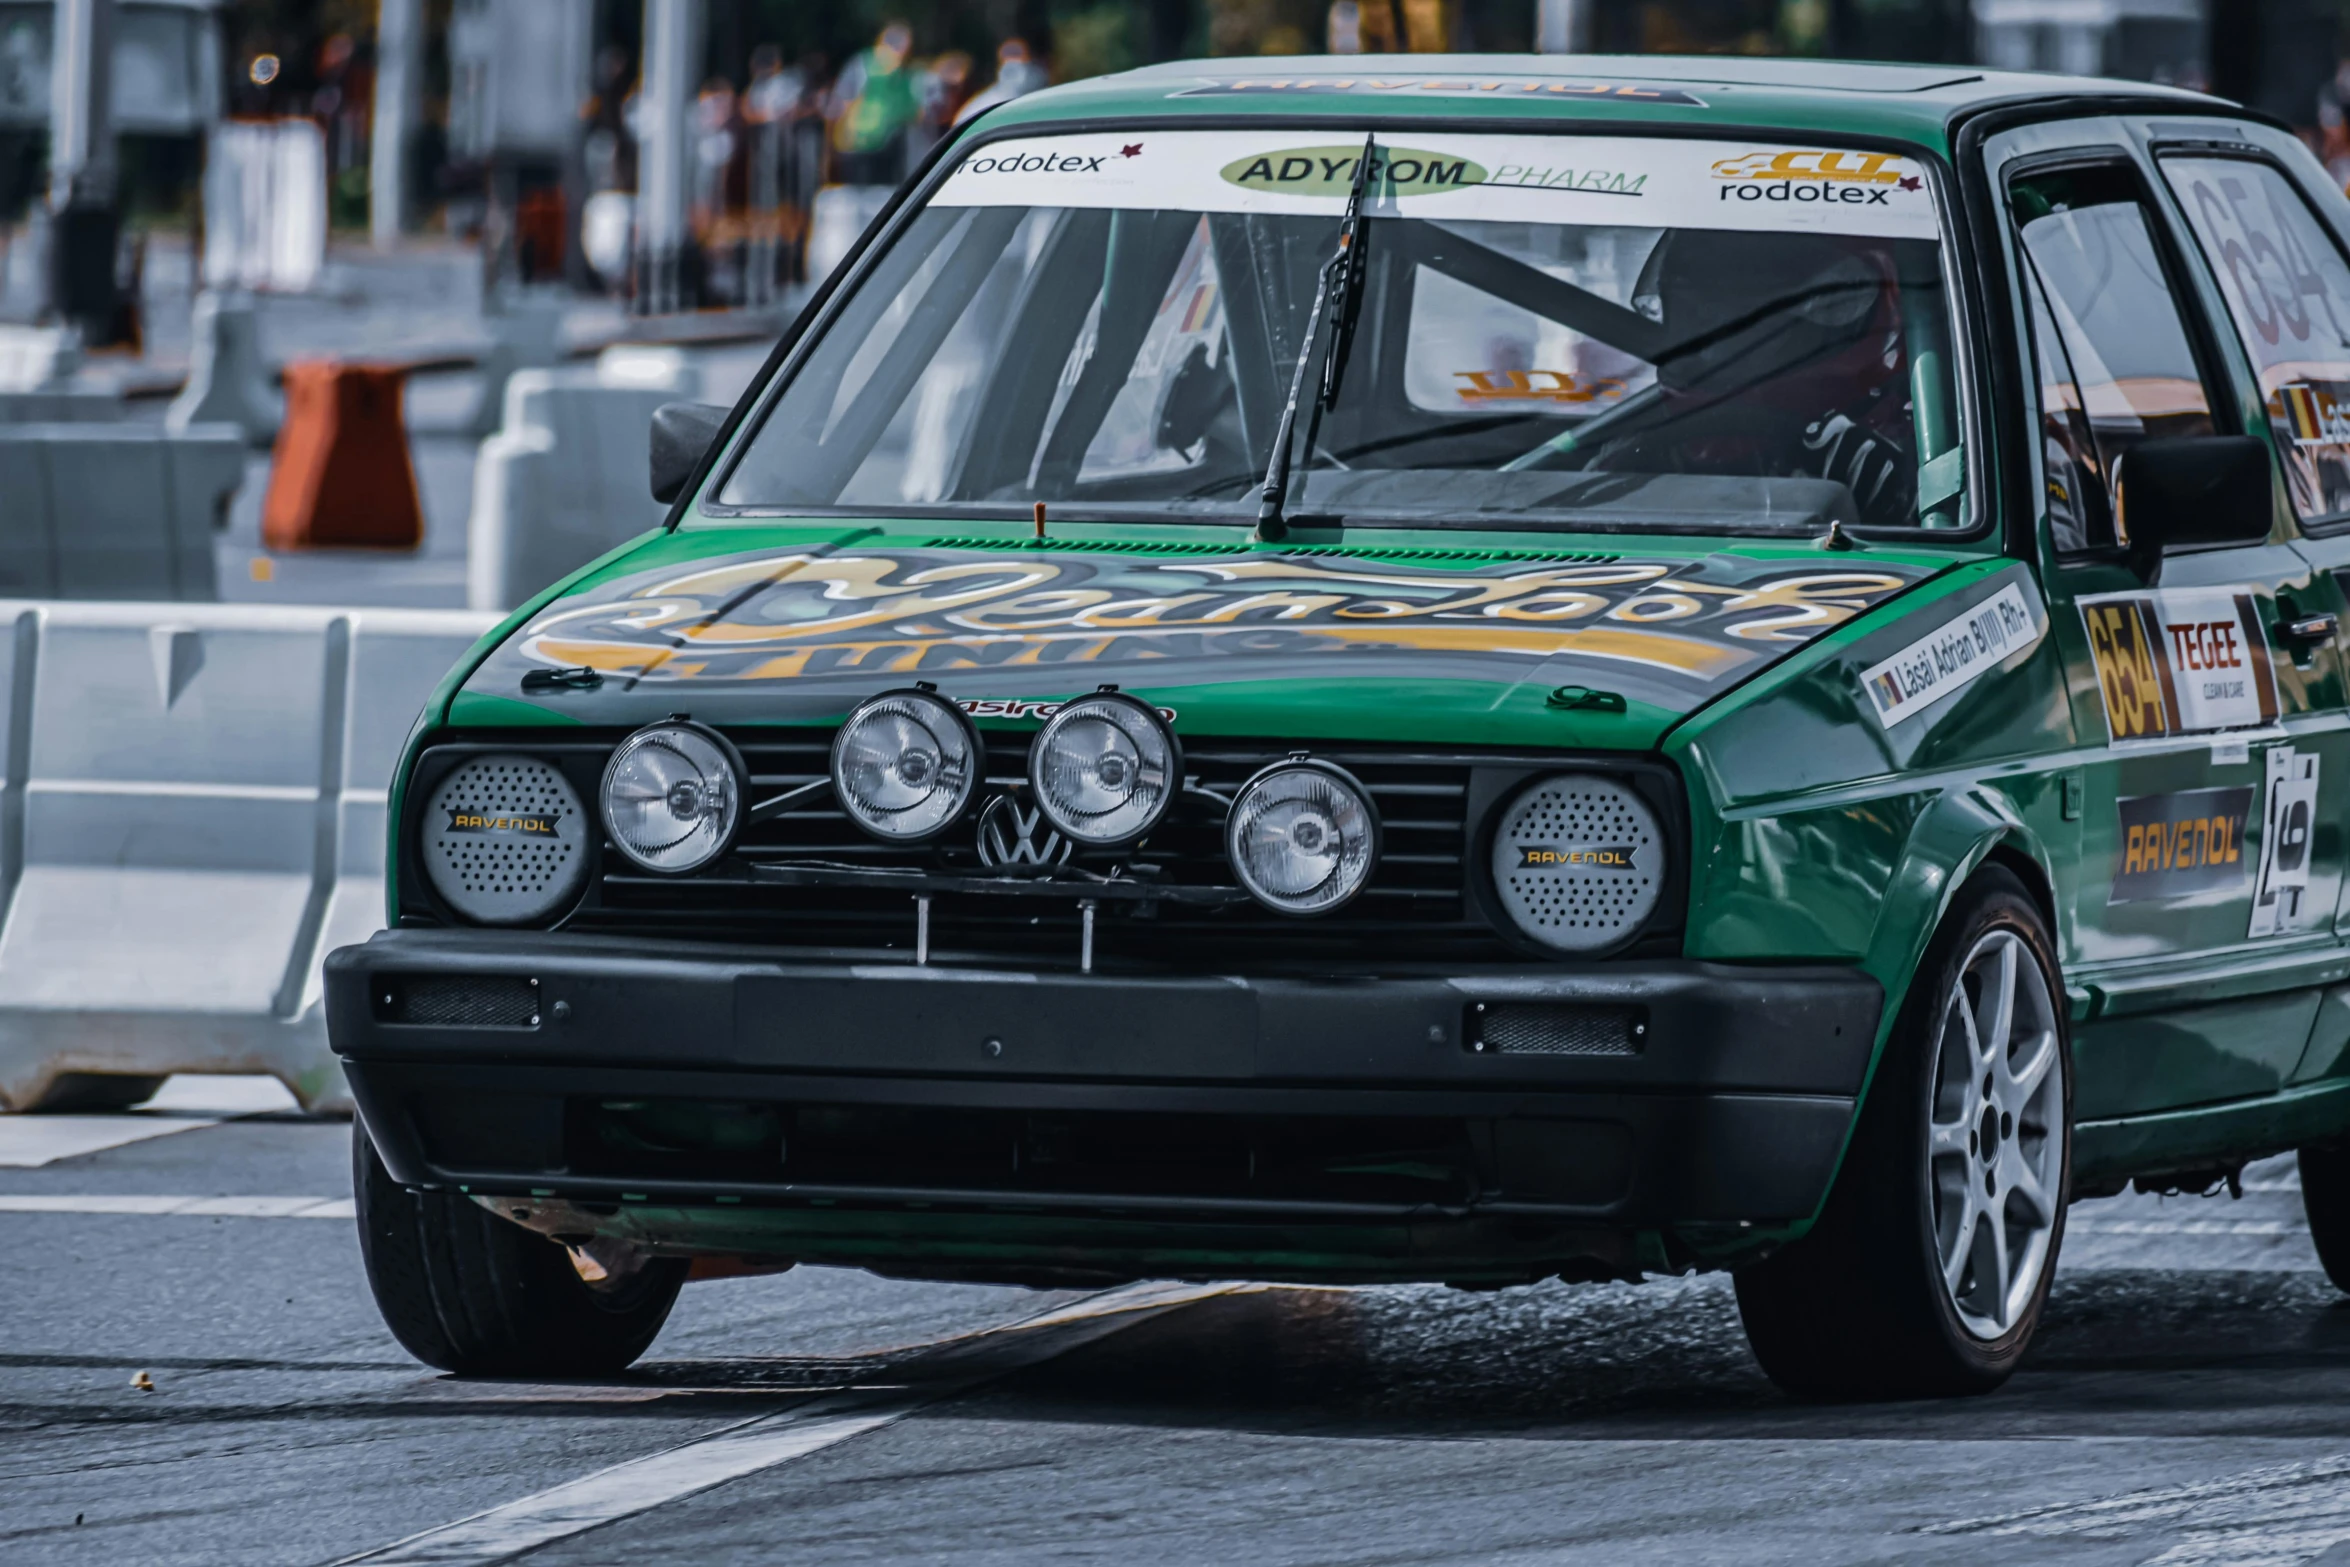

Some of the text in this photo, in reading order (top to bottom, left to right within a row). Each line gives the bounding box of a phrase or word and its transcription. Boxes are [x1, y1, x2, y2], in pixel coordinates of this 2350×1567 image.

[957, 153, 1107, 175] rodotex
[1237, 157, 1649, 194] ADYROM PHARM
[1720, 180, 1890, 206] rodotex
[1931, 633, 1977, 679] Adrian
[2166, 620, 2242, 672] TEGEE
[2087, 606, 2164, 737] 654
[455, 815, 550, 832] RAVENOL
[1527, 851, 1626, 865] RAVENOL
[2125, 815, 2240, 875] RAVENOL
